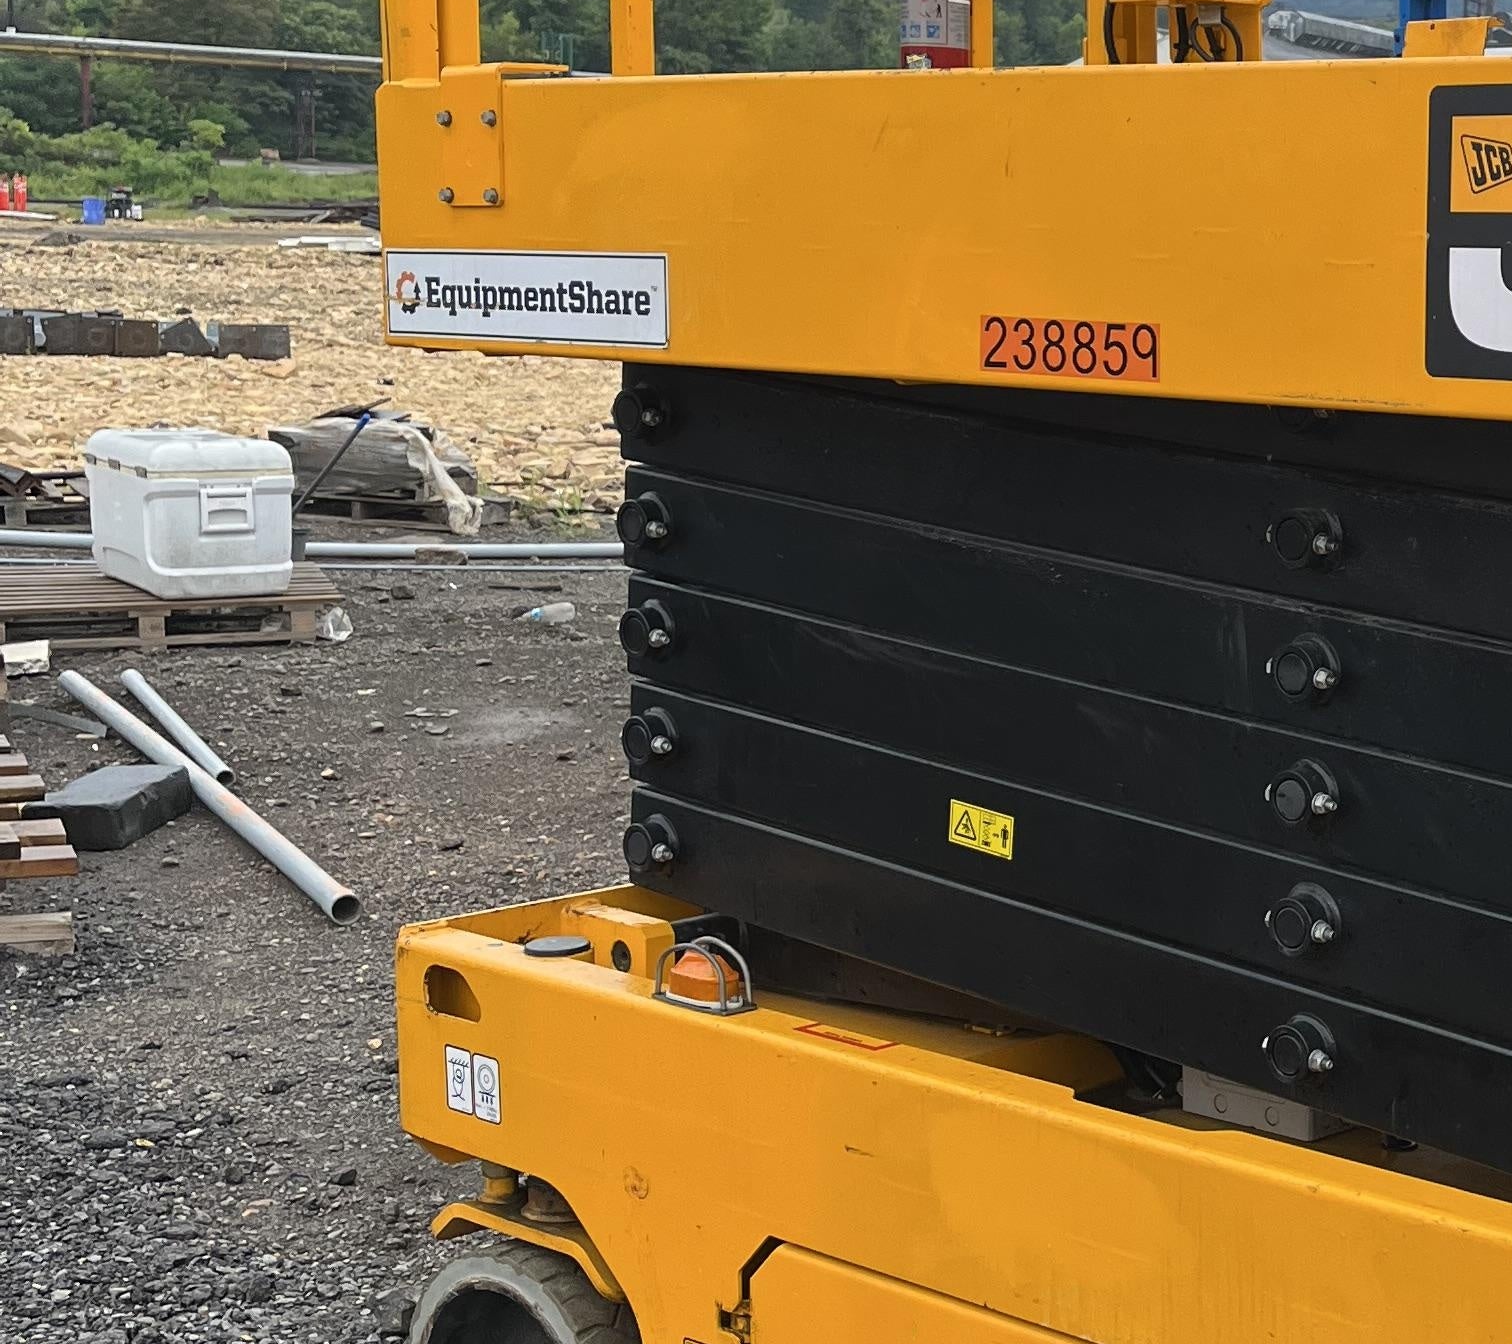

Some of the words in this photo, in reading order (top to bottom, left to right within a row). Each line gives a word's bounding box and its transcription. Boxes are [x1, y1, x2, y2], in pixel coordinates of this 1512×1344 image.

[1471, 141, 1512, 187] JCB
[425, 277, 651, 317] EquipmentShare
[984, 317, 1157, 378] 238859
